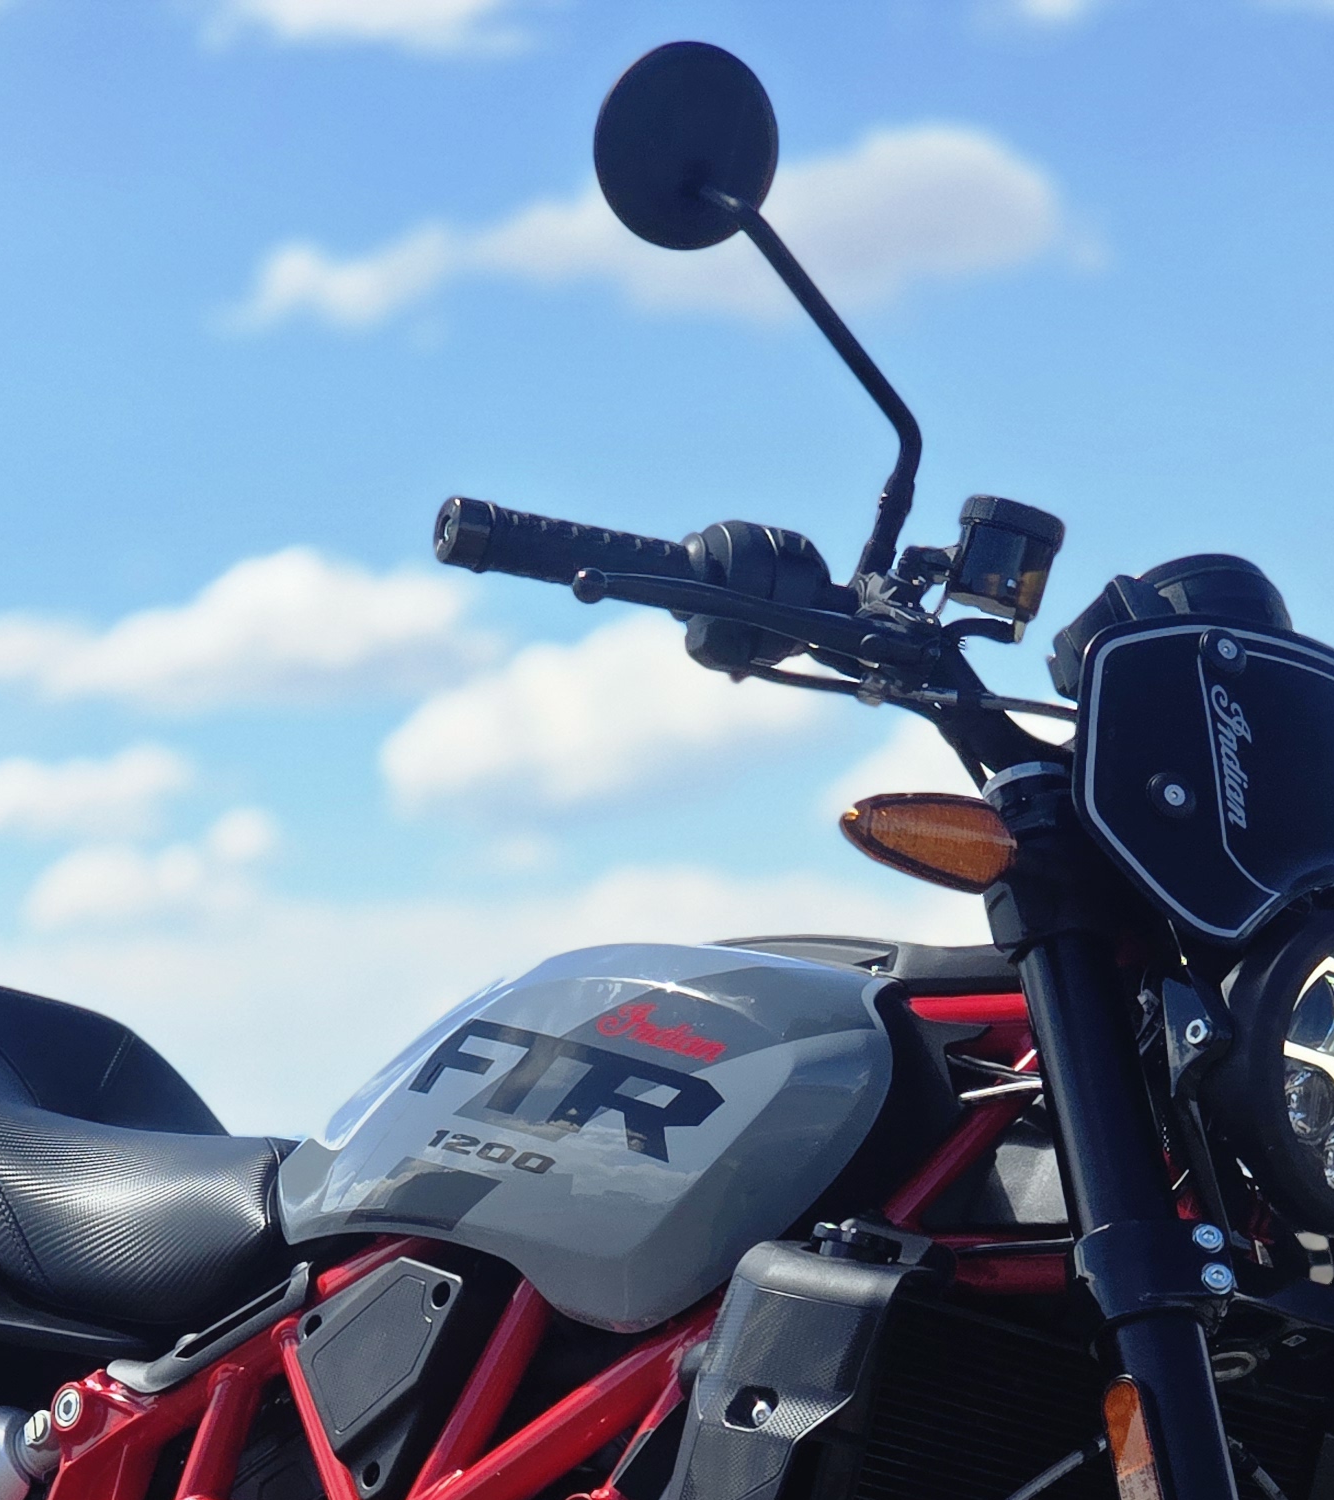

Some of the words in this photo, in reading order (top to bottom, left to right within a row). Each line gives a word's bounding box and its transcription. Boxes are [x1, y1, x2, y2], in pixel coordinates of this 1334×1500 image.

[1211, 684, 1252, 830] Indian
[596, 1001, 727, 1064] Indian
[427, 1129, 555, 1175] 1200
